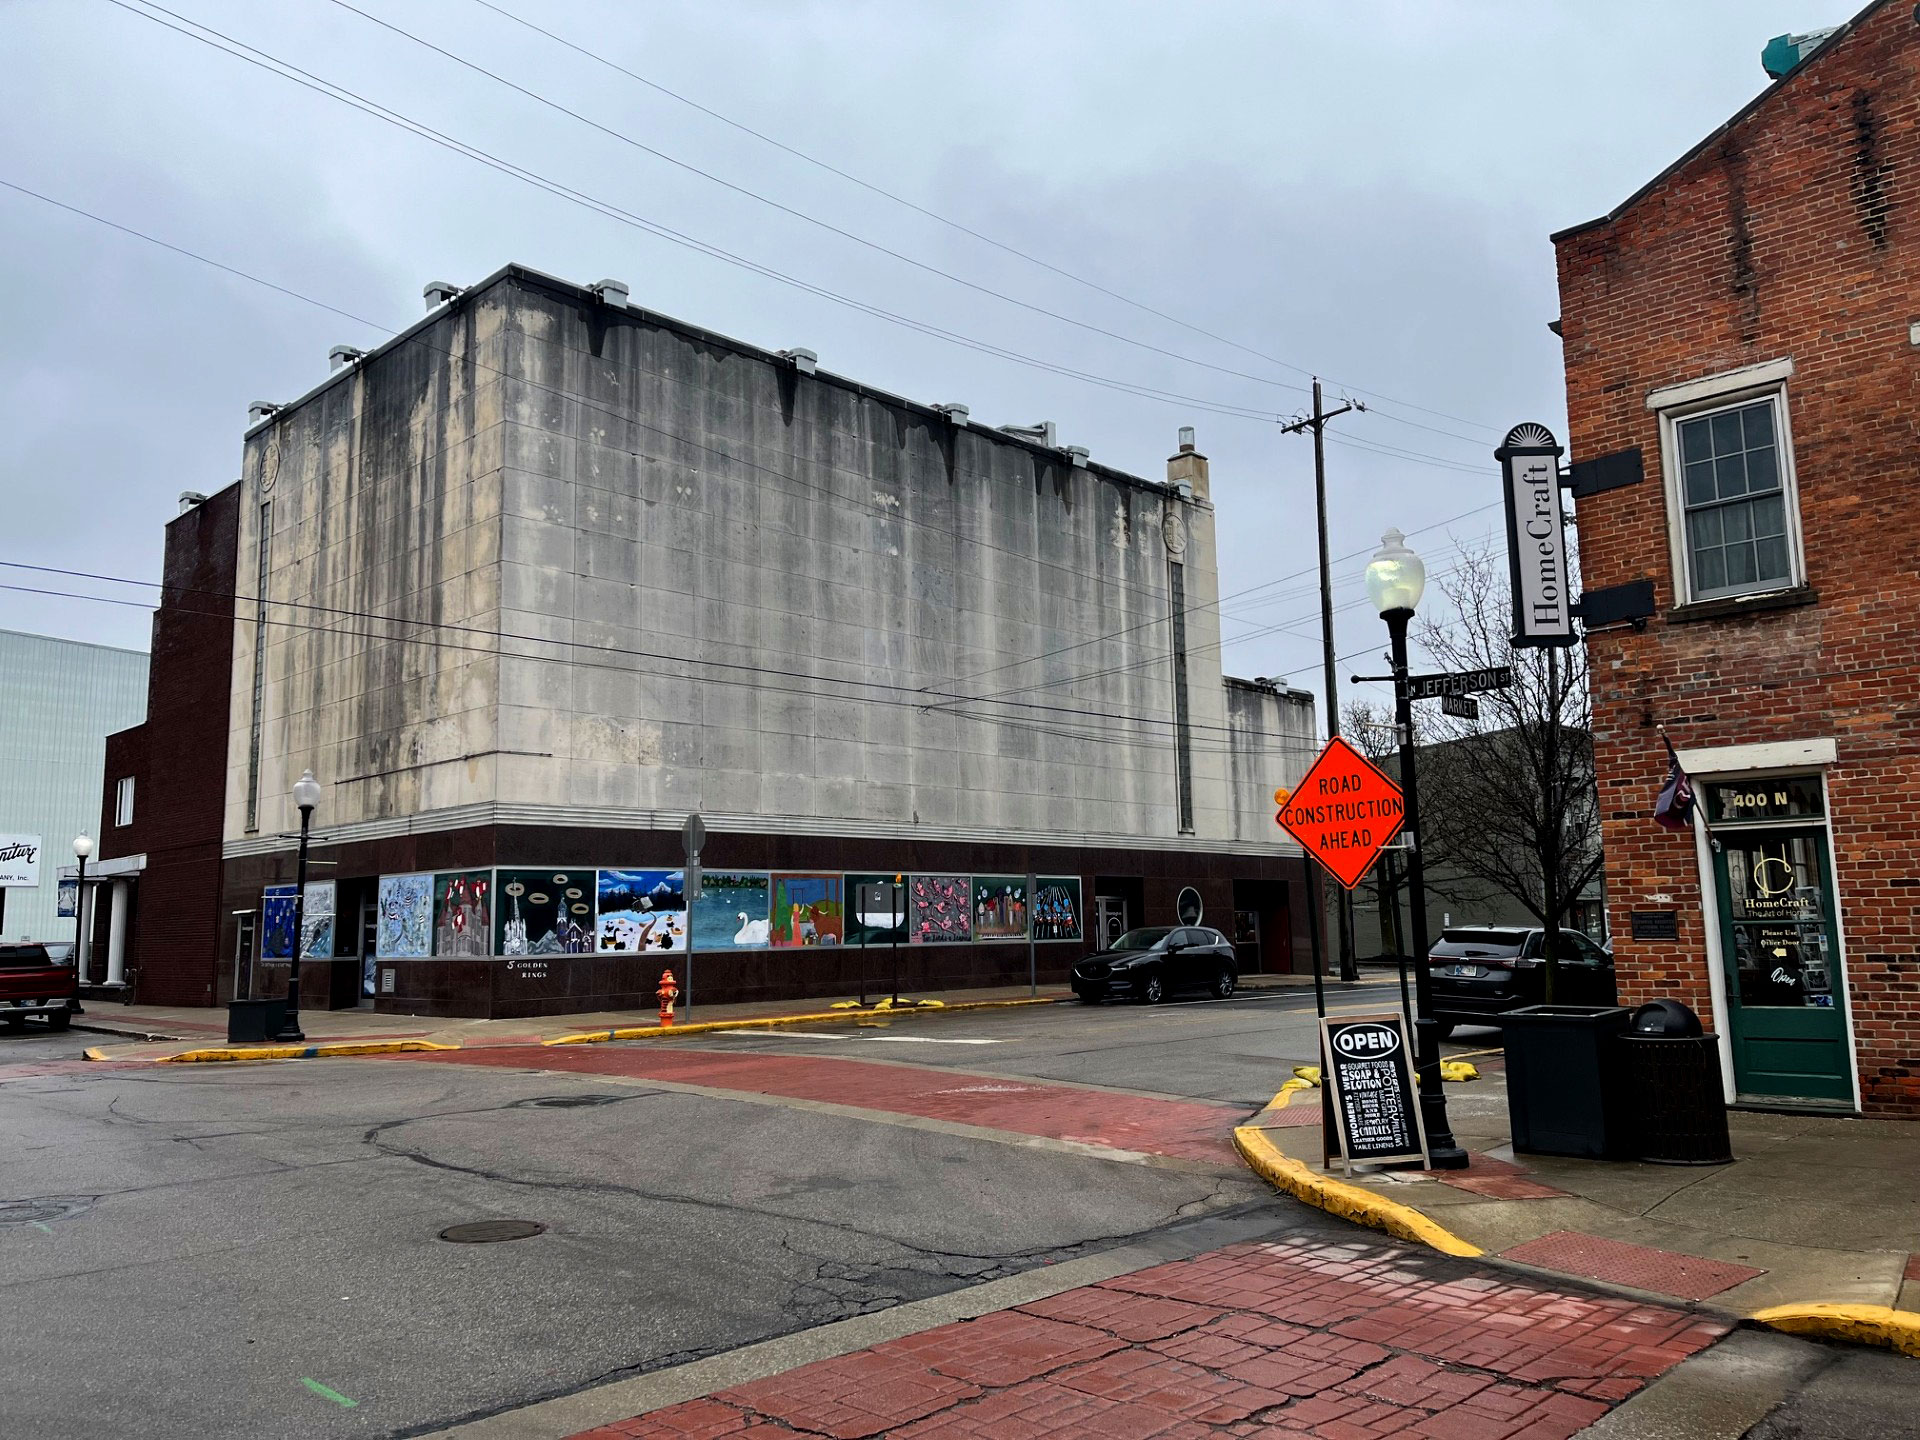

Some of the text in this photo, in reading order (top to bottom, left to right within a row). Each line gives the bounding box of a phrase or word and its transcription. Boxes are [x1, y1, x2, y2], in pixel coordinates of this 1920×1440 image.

[1523, 463, 1561, 628] HomeCraft
[1419, 671, 1497, 696] JEFFERSON
[1500, 672, 1510, 682] ST
[1442, 695, 1472, 716] MARKET
[1318, 774, 1362, 796] ROAD
[1733, 791, 1788, 807] 400 N
[1284, 797, 1403, 827] CONSTRUCTION
[1319, 829, 1372, 851] AHEAD
[1745, 897, 1809, 909] HomeCraft
[507, 960, 515, 970] 5
[1770, 967, 1796, 986] Open
[1340, 1031, 1393, 1051] OPEN
[1347, 1061, 1388, 1070] GOURMET FOODS
[1348, 1069, 1380, 1081] SOAP &
[1350, 1079, 1382, 1090] LOTION
[1380, 1068, 1399, 1121] POTTERY
[1340, 1063, 1359, 1139] WOMEN'S WEAR
[1359, 1125, 1391, 1136] CANDLES
[1391, 1120, 1403, 1147] PILLOWS
[1372, 1142, 1394, 1150] LINENS
